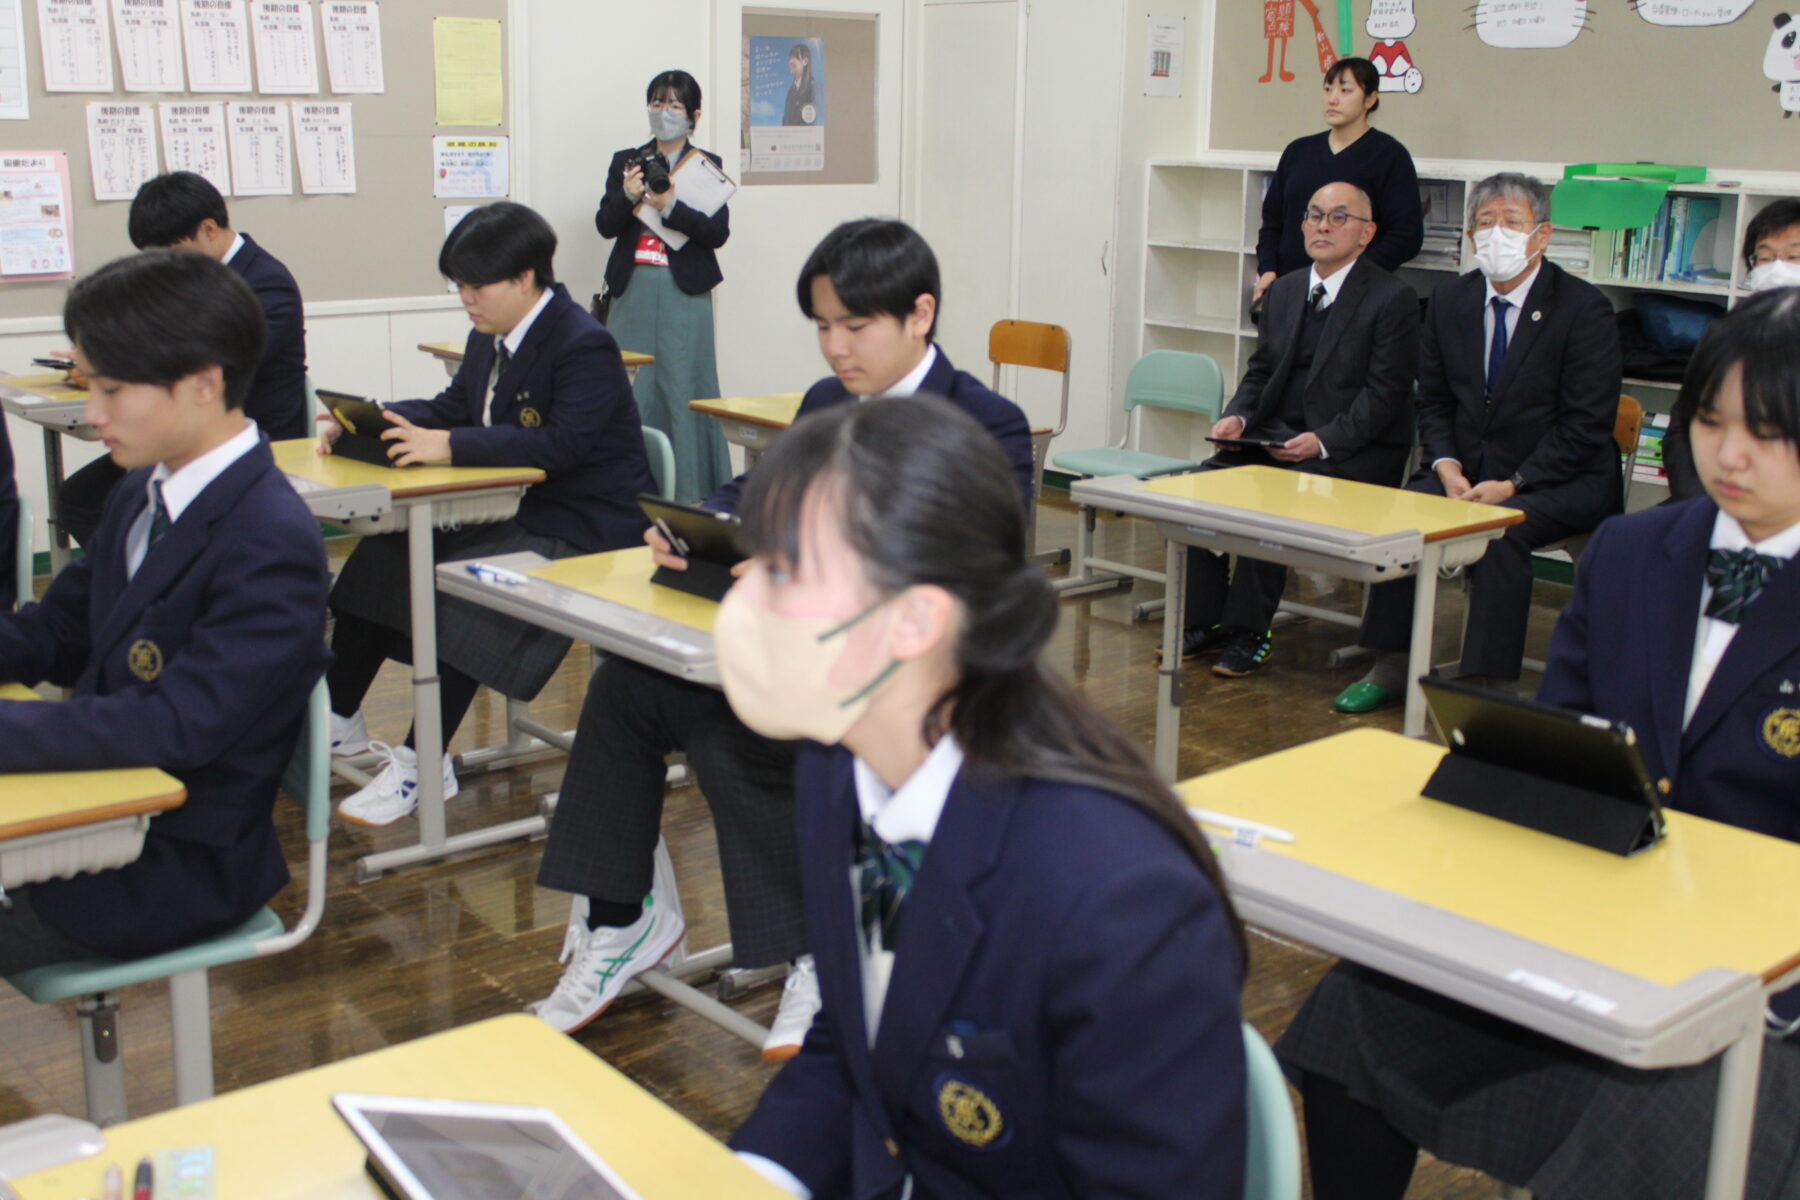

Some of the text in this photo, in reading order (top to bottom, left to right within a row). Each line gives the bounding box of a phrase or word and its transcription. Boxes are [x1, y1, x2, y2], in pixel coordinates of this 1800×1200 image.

[194, 0, 232, 9] 後期の目標
[263, 4, 300, 13] 後期の目標
[332, 5, 367, 14] 後期の目標
[101, 106, 140, 115] 後期の目標
[171, 106, 210, 115] 後期の目標
[239, 106, 276, 115] 後期の目標
[304, 106, 339, 115] 後期の目標
